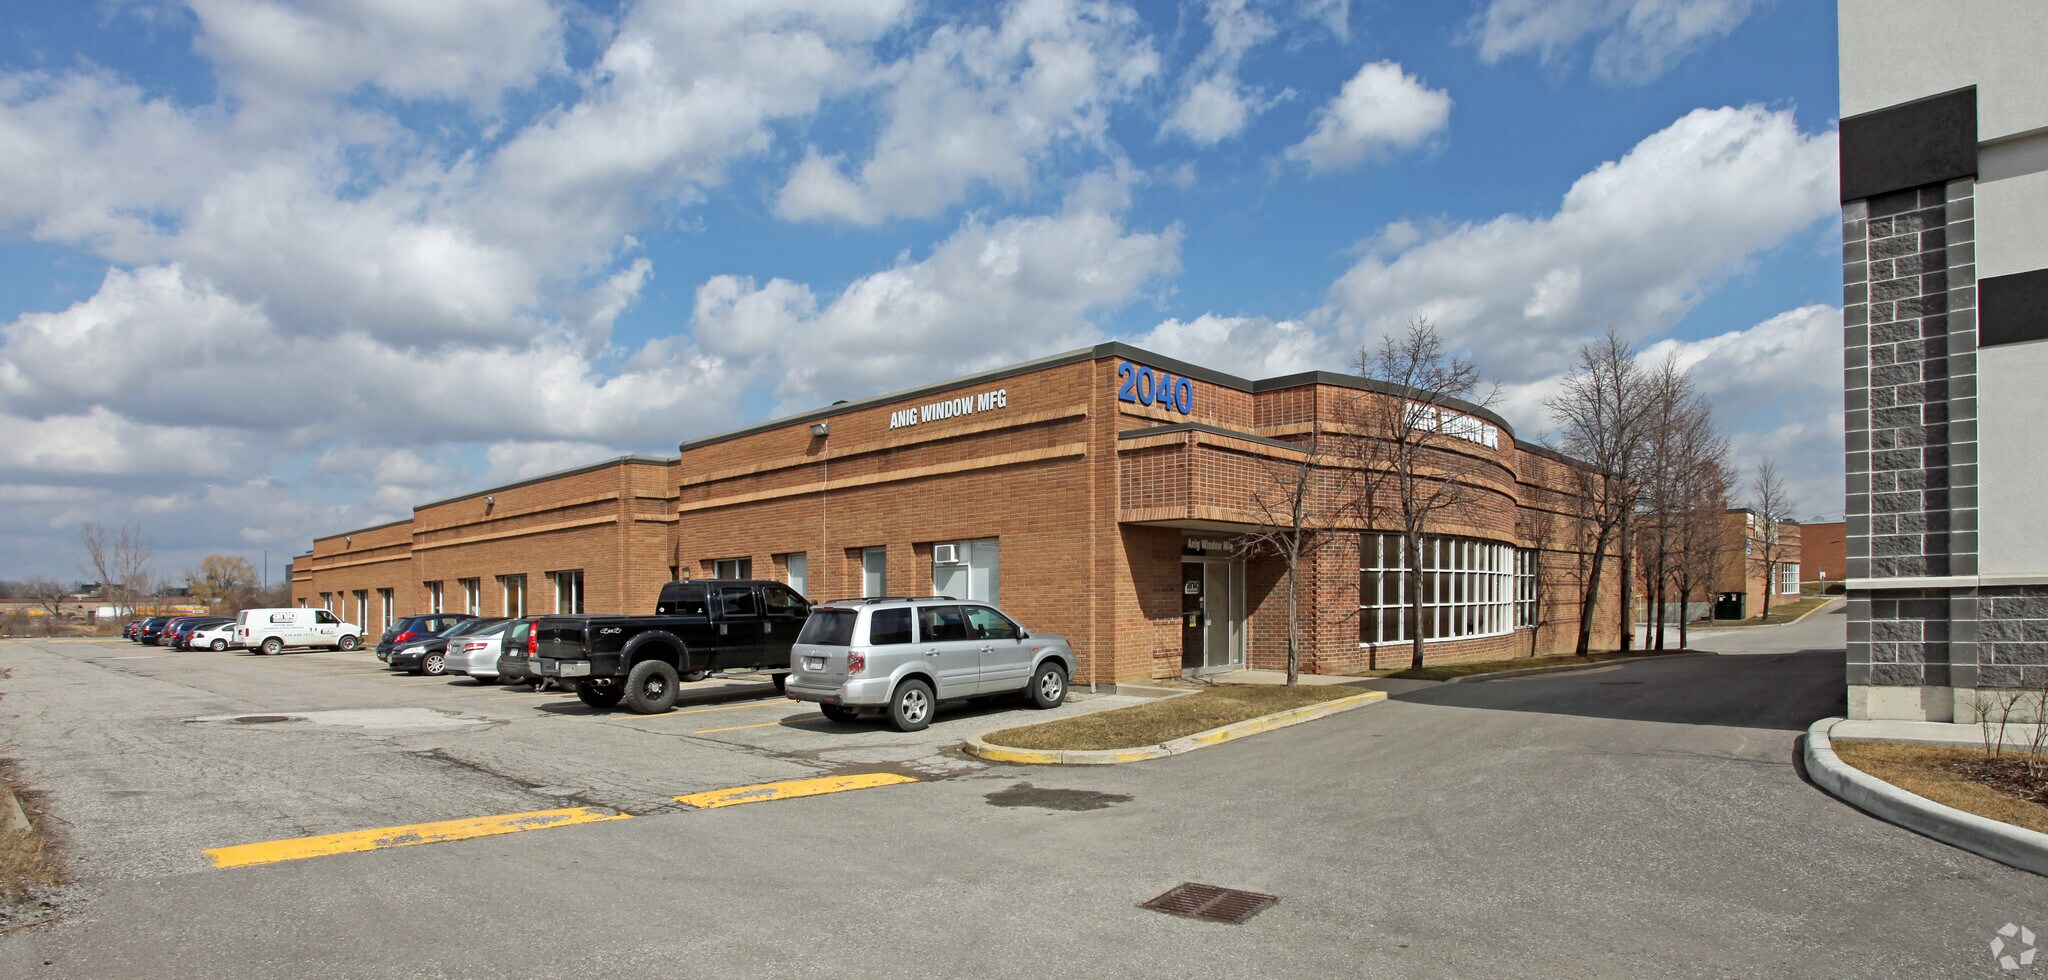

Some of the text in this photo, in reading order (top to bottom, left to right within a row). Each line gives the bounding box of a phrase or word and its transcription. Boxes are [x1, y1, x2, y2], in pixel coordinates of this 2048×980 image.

[1118, 361, 1193, 415] 2040
[890, 389, 1007, 430] ANIG WINDOW MFG
[1187, 538, 1200, 552] Anig
[1201, 539, 1222, 550] Window
